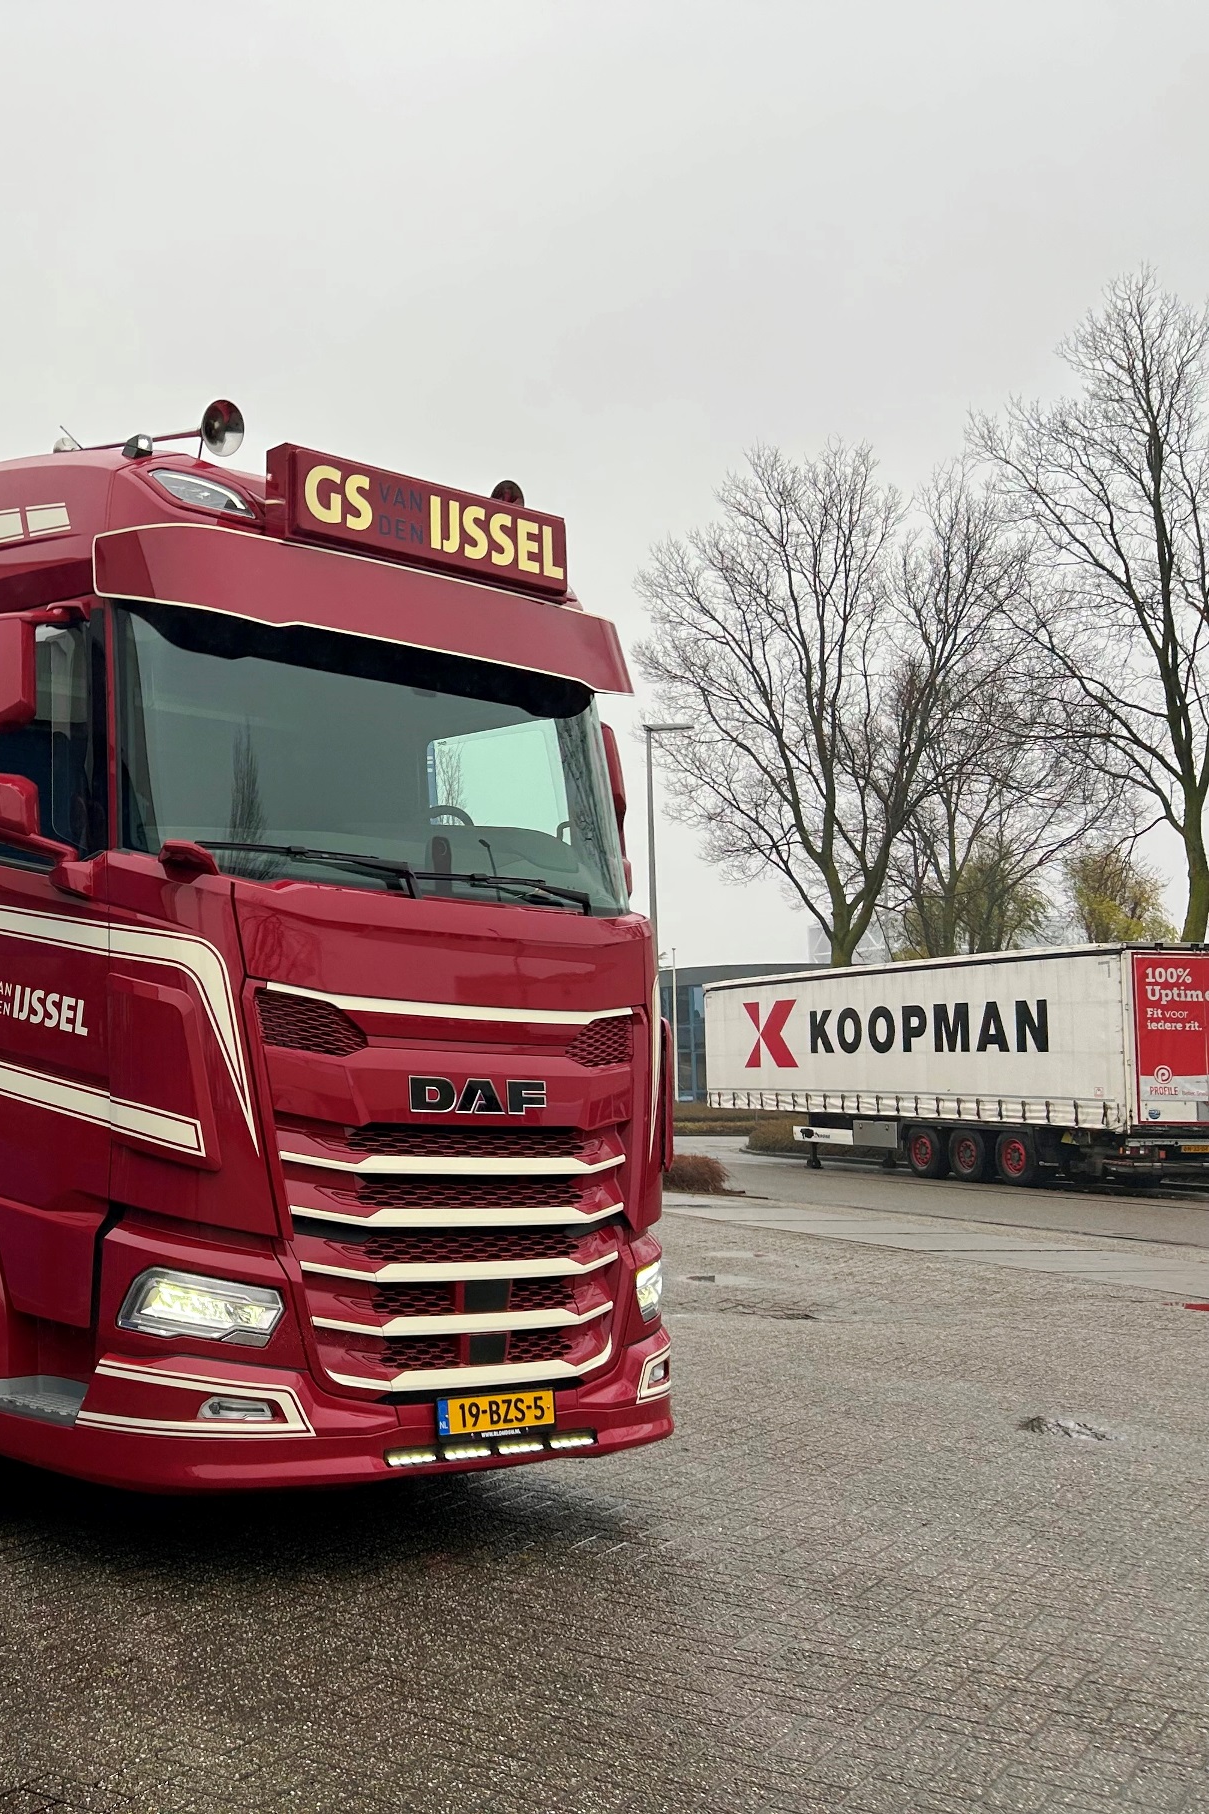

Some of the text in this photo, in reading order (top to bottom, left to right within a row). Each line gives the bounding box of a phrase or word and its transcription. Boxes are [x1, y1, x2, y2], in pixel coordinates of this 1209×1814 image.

[304, 465, 564, 580] GS VAN DEN IJSSEL
[1145, 967, 1192, 983] 100%
[13, 985, 88, 1036] IJSSEL
[809, 998, 1050, 1054] KOOPMAN
[1146, 1008, 1162, 1018] Fit
[1147, 1020, 1202, 1031] iedere rit.
[408, 1075, 547, 1115] DAF
[1150, 1086, 1178, 1096] PROFILE
[439, 1396, 545, 1430] NL 19-BZS-5
